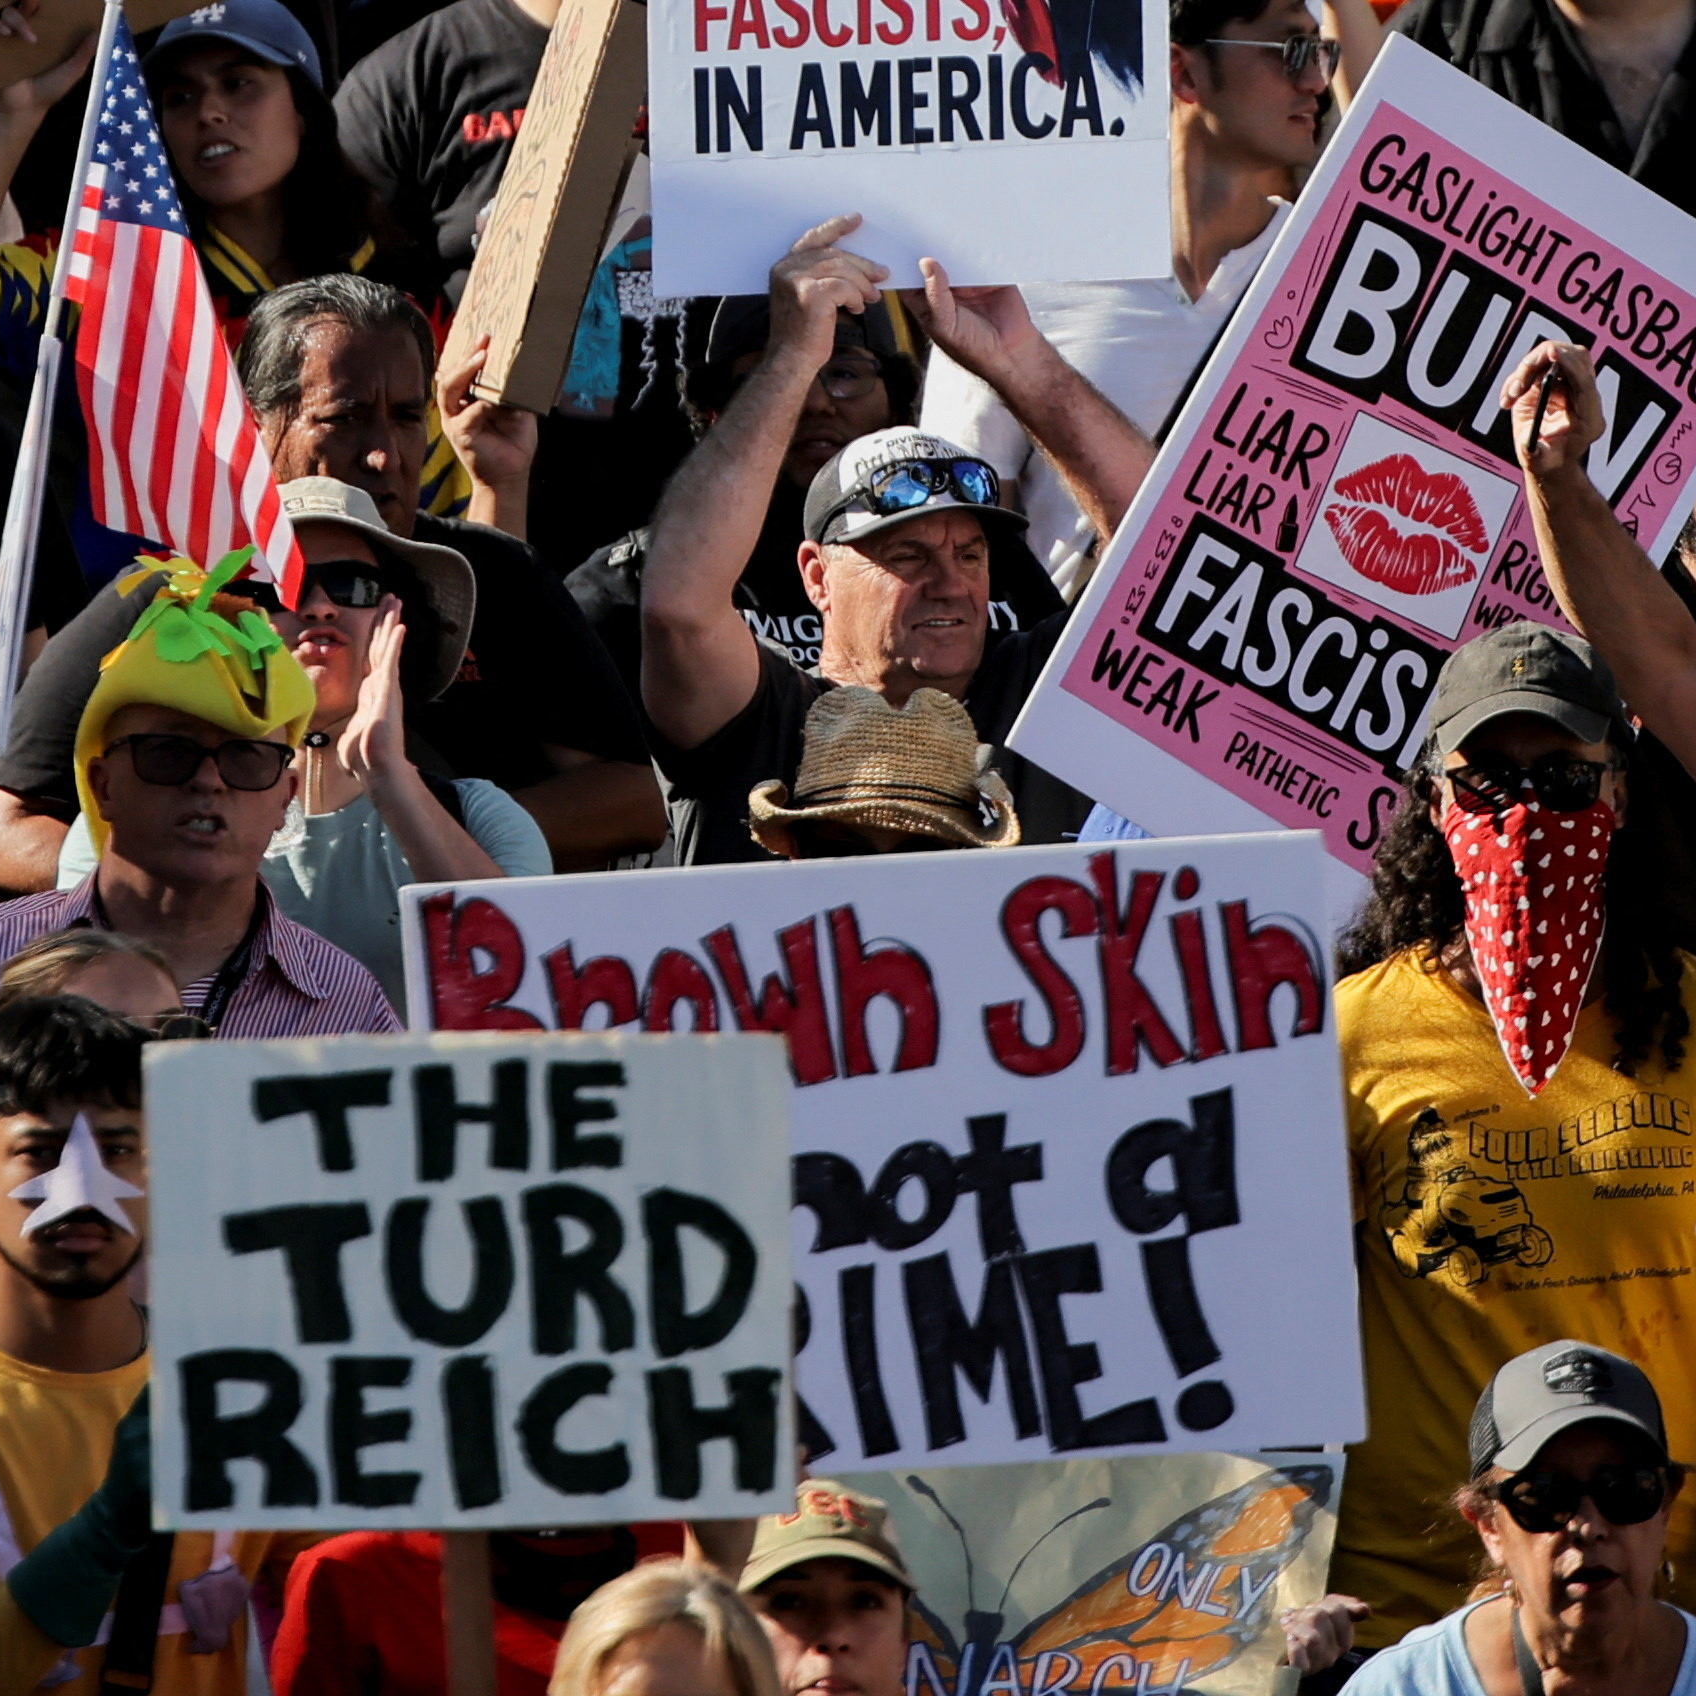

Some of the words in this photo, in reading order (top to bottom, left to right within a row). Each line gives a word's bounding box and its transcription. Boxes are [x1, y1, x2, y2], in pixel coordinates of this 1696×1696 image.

[692, 61, 765, 156] IN
[788, 50, 1127, 151] AMERICA.
[1090, 629, 1221, 744] WEAK
[418, 890, 942, 1091] Brown
[983, 849, 1329, 1081] Skin
[250, 1055, 628, 1183] THE
[1469, 1120, 1550, 1166] FOUR
[1557, 1090, 1694, 1156] SEASONS
[1681, 1179, 1695, 1195] PA
[223, 1179, 758, 1359] TURD
[179, 1346, 782, 1513] REICH
[1126, 1540, 1280, 1623] ONLY
